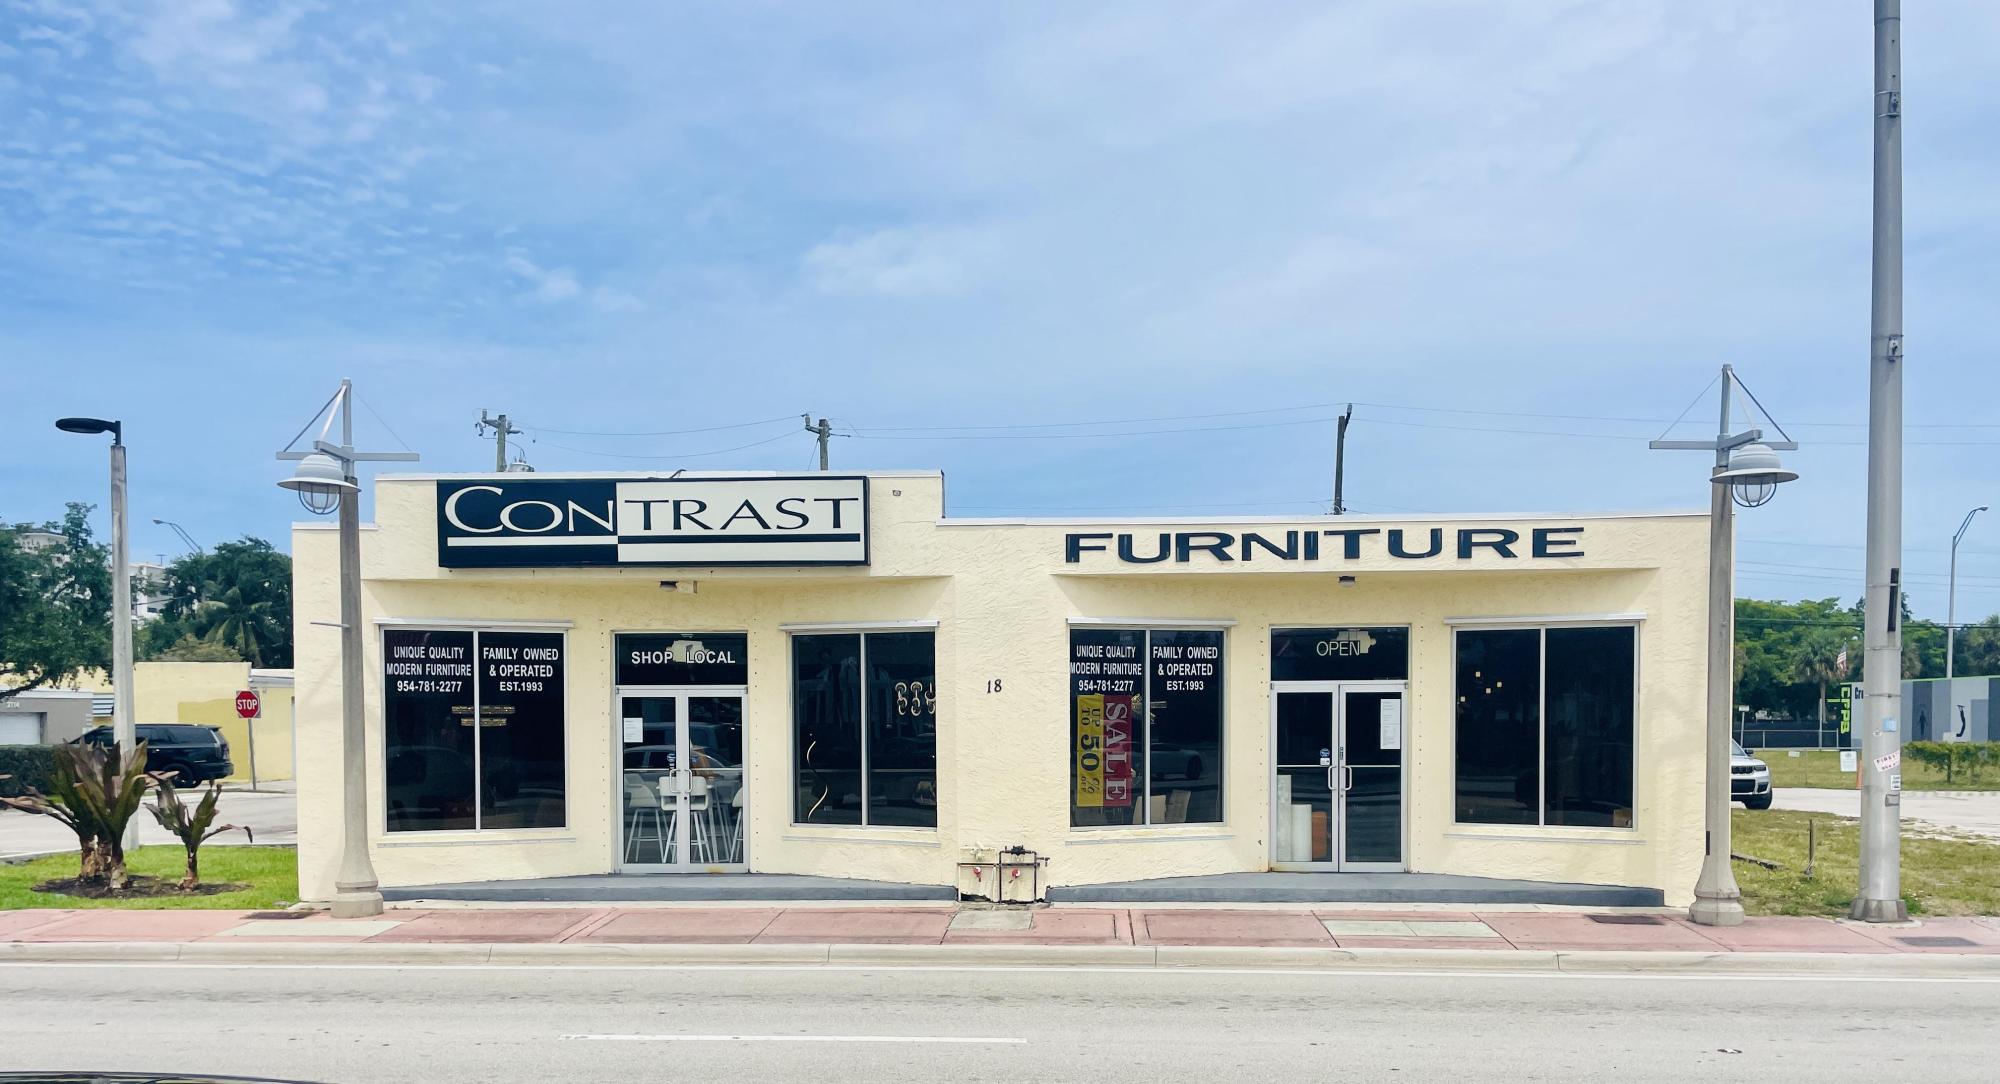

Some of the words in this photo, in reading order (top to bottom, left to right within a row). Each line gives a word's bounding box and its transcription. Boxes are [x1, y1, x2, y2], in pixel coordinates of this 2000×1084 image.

[1065, 527, 1585, 564] FURNITURE
[393, 646, 426, 659] UNIQUE
[428, 647, 464, 660] QUALITY
[483, 647, 518, 660] FAMILY
[523, 648, 559, 661] OWNED
[1076, 645, 1103, 658] UNIQUE
[1105, 646, 1136, 659] QUALITY
[1152, 646, 1183, 659] FAMILY
[1187, 646, 1218, 659] OWNED
[1316, 641, 1360, 656] OPEN
[631, 651, 673, 664] SHOP
[686, 651, 736, 664] LOCAL
[386, 663, 422, 676] MODERN
[425, 663, 472, 676] FURNITURE
[489, 664, 497, 677] &
[500, 664, 554, 677] OPERATED
[1070, 662, 1100, 675] MODERN
[1103, 662, 1142, 676] FURNITURE
[1157, 664, 1165, 676] &
[1166, 663, 1213, 676] OPERATED
[397, 681, 462, 693] 954-781-2277
[499, 681, 543, 692] EST.1993
[987, 679, 1002, 694] 18
[1078, 680, 1134, 692] 954-781-2277
[1166, 680, 1204, 691] EST.1993
[237, 699, 258, 710] STOP
[1080, 707, 1091, 726] TO
[1091, 707, 1101, 727] UP
[1105, 702, 1128, 800] SALE
